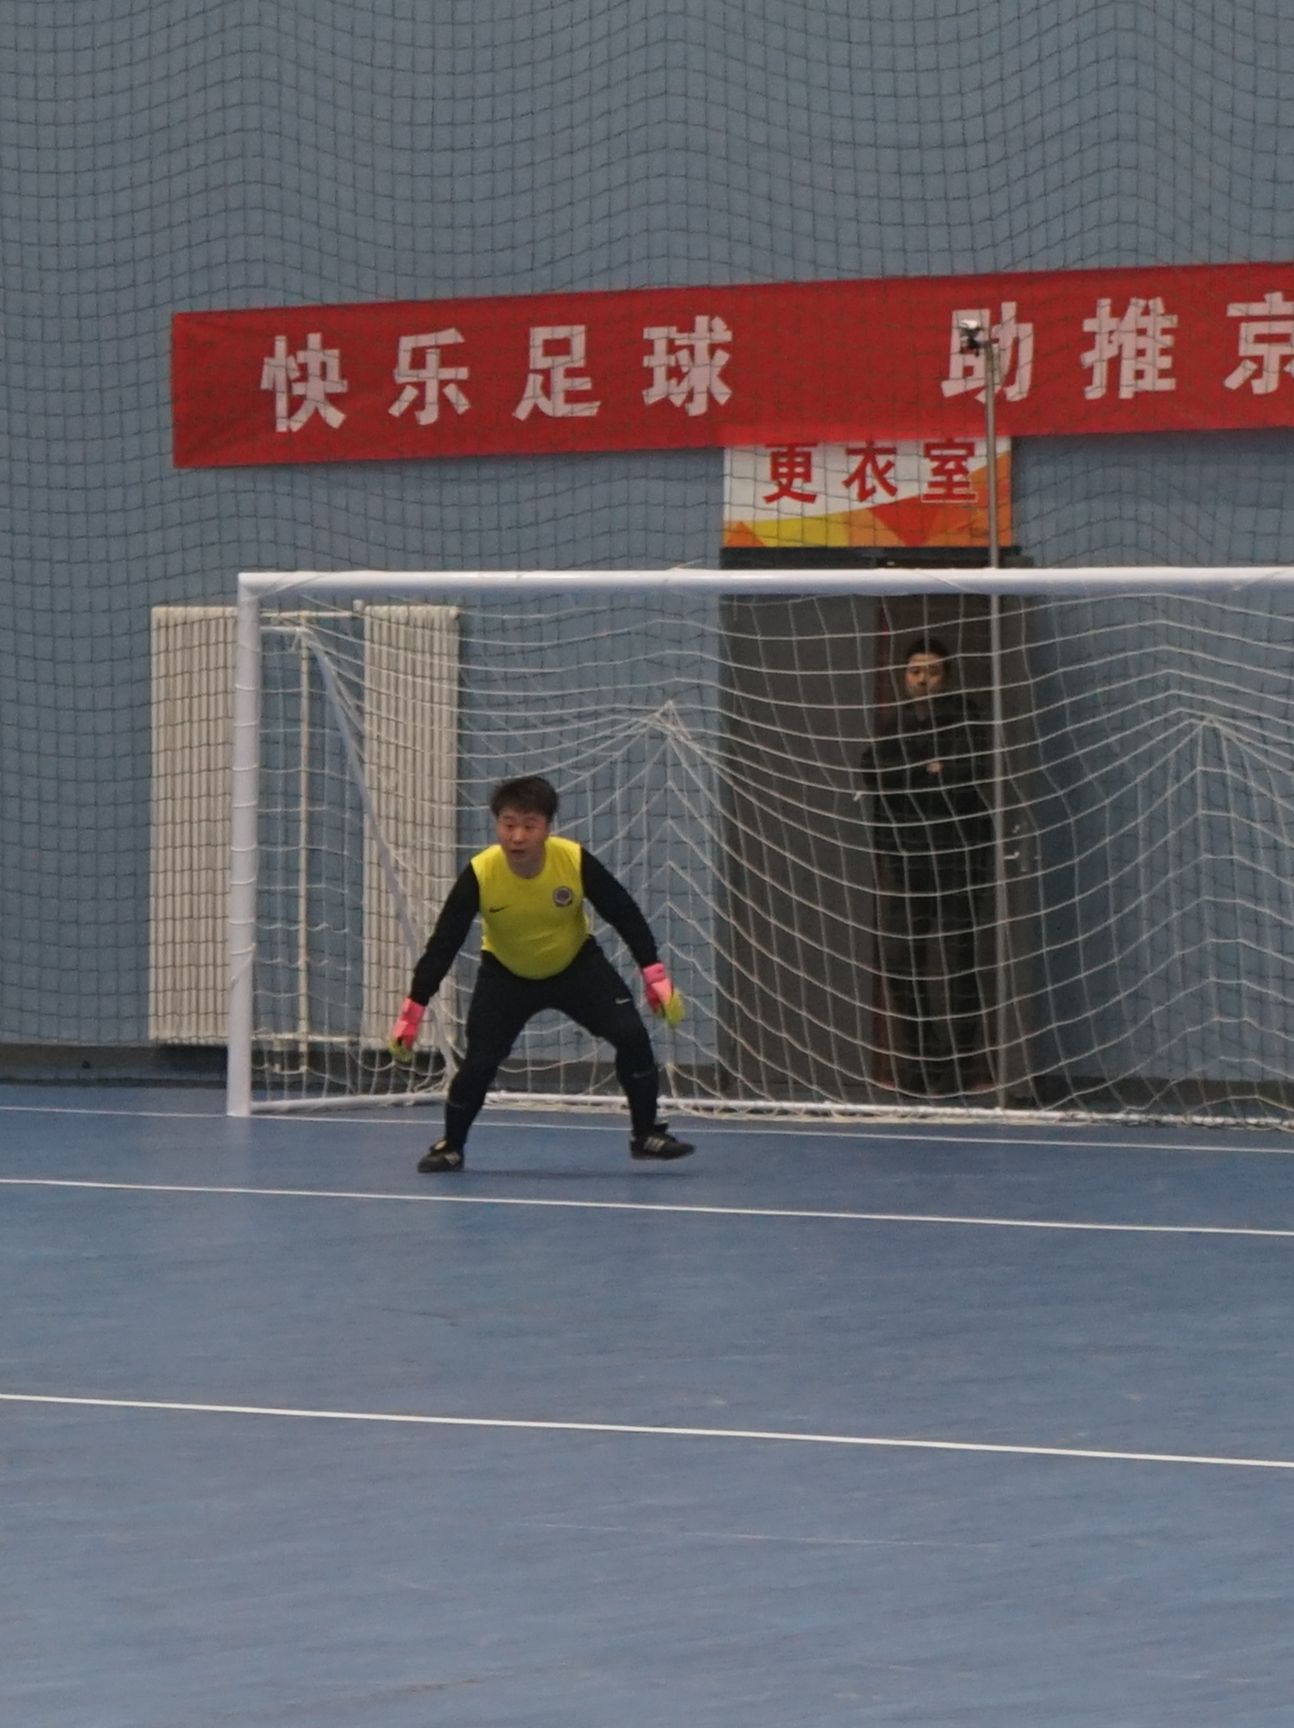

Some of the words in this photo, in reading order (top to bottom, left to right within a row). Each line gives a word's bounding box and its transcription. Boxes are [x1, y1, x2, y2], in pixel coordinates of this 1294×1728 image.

[260, 315, 733, 433] 快乐足球
[762, 437, 977, 504] 更衣室
